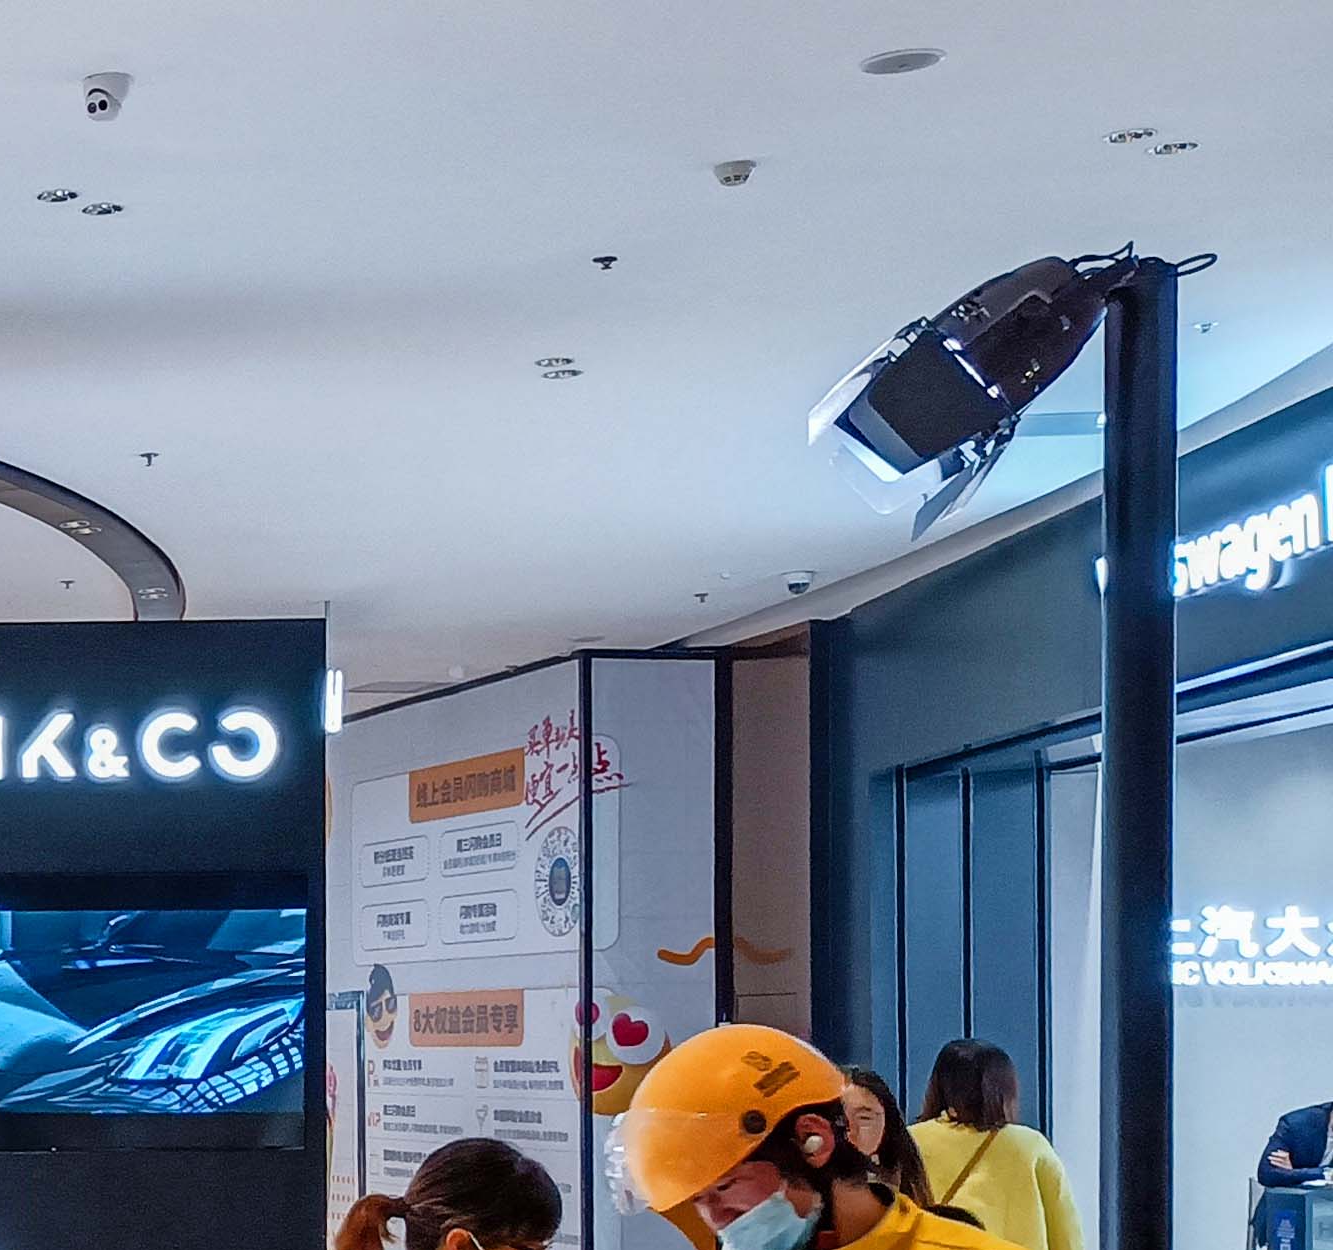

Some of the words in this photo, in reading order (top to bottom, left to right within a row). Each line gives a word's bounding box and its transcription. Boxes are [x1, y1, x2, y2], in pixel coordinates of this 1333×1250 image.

[1173, 494, 1321, 598] swagen
[1171, 905, 1333, 957] 汽大
[413, 1003, 518, 1034] 8大权益会员专享
